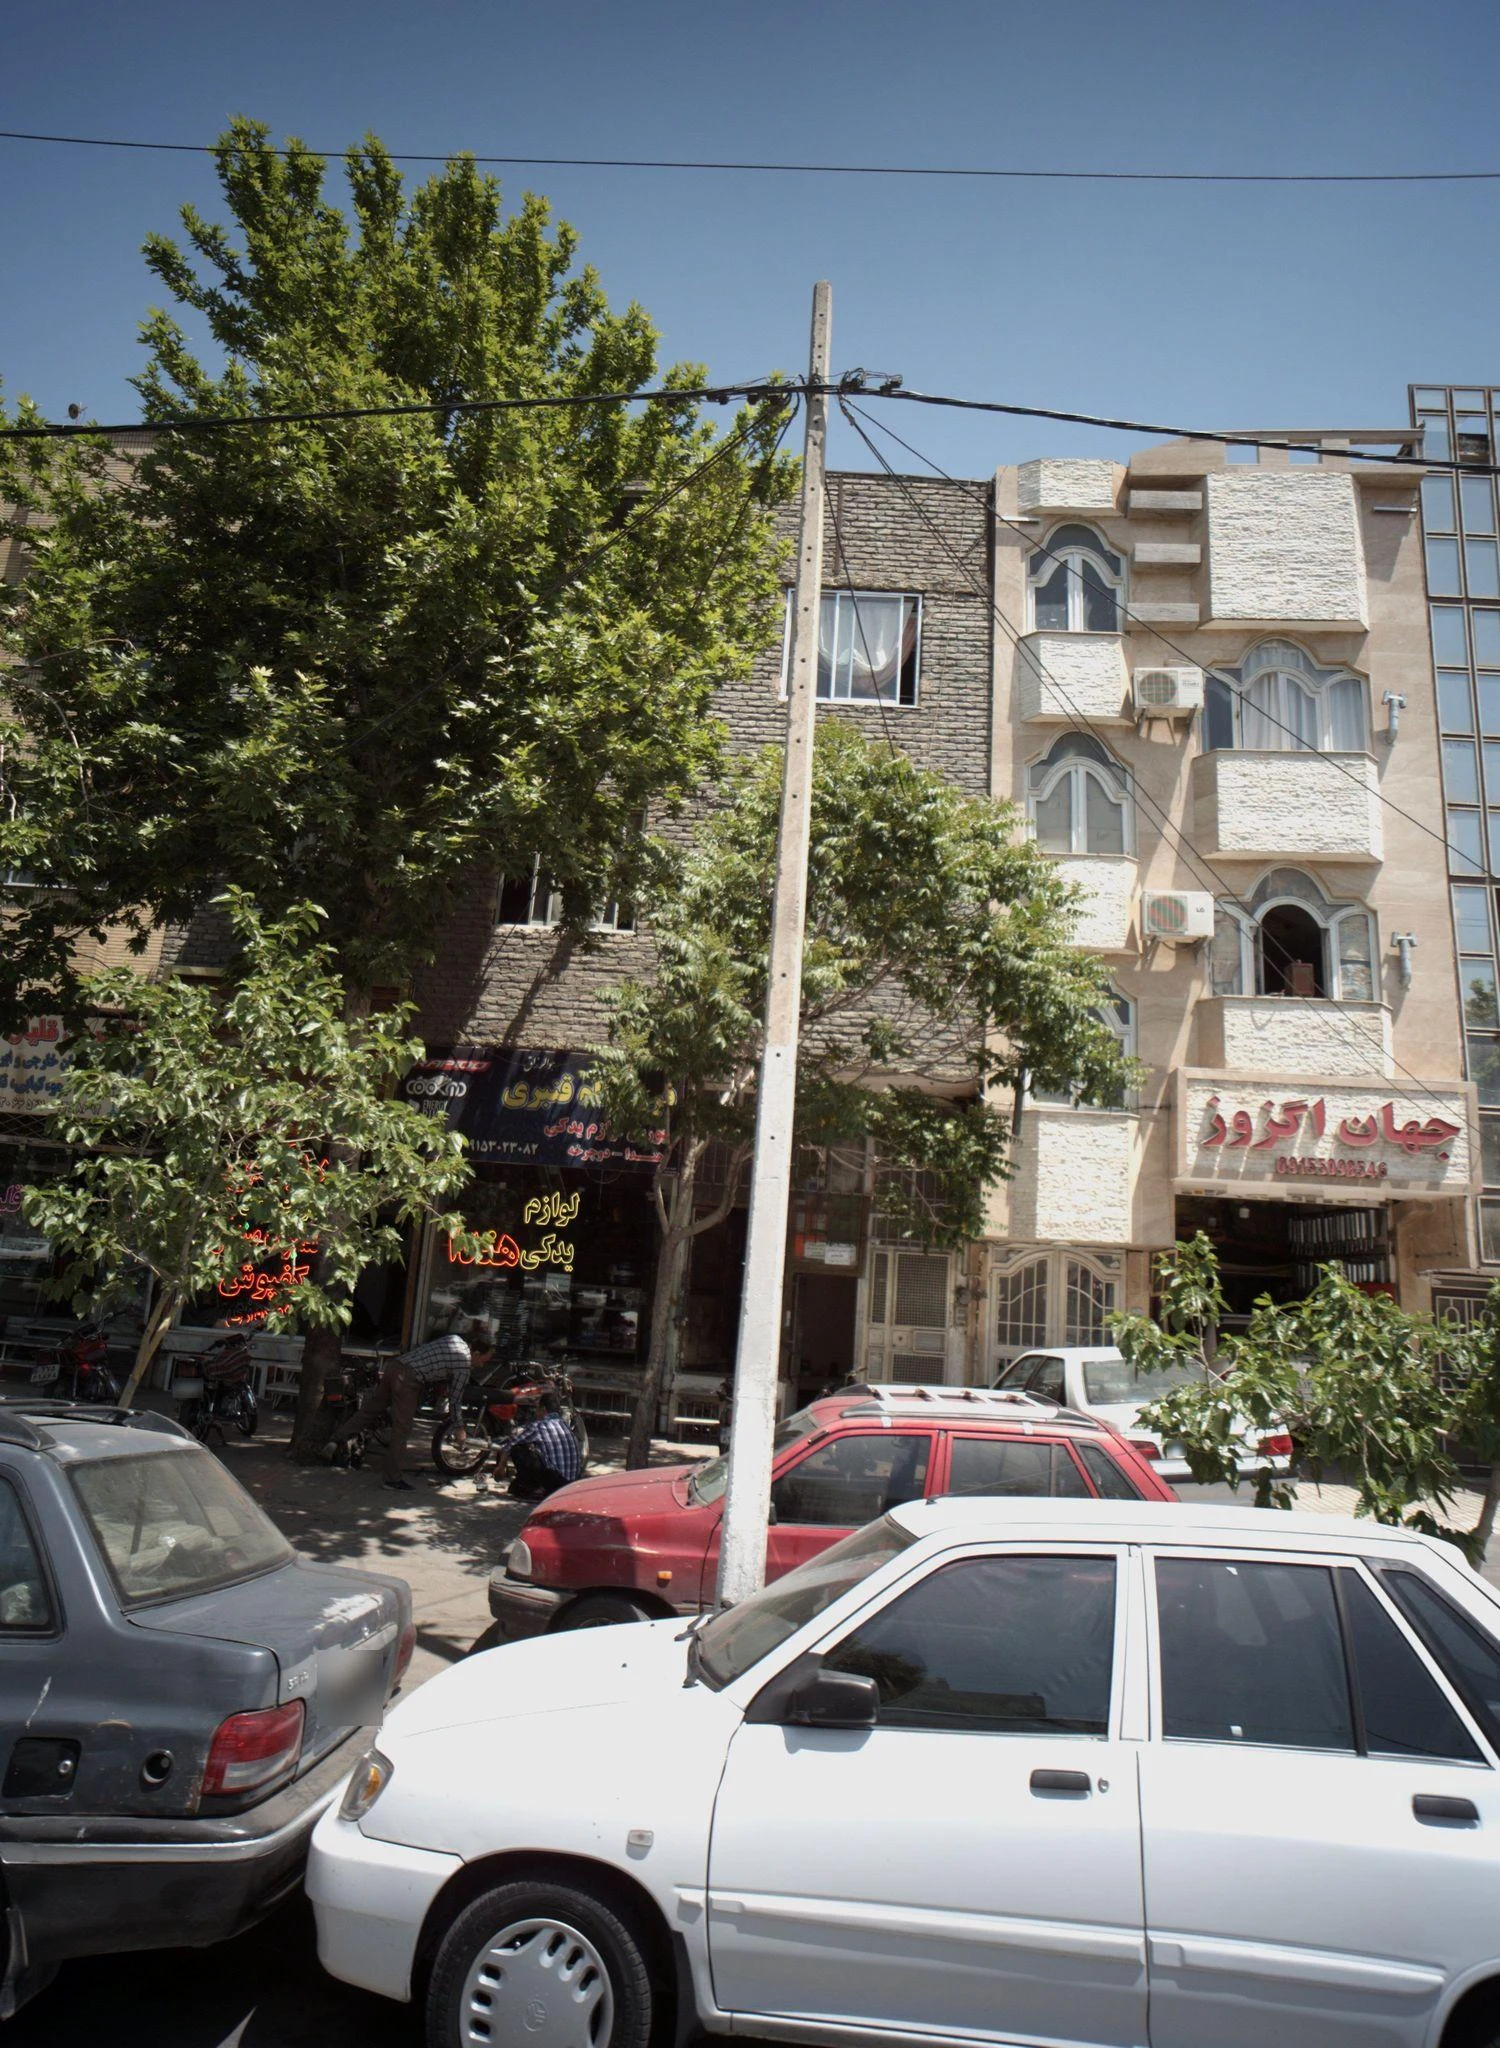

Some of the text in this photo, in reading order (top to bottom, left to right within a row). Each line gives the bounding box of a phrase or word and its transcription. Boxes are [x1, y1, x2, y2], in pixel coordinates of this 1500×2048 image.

[502, 1075, 574, 1112] قنبری
[1338, 1102, 1462, 1162] جهان
[523, 1191, 580, 1227] لوازم
[519, 1233, 575, 1272] یدکی
